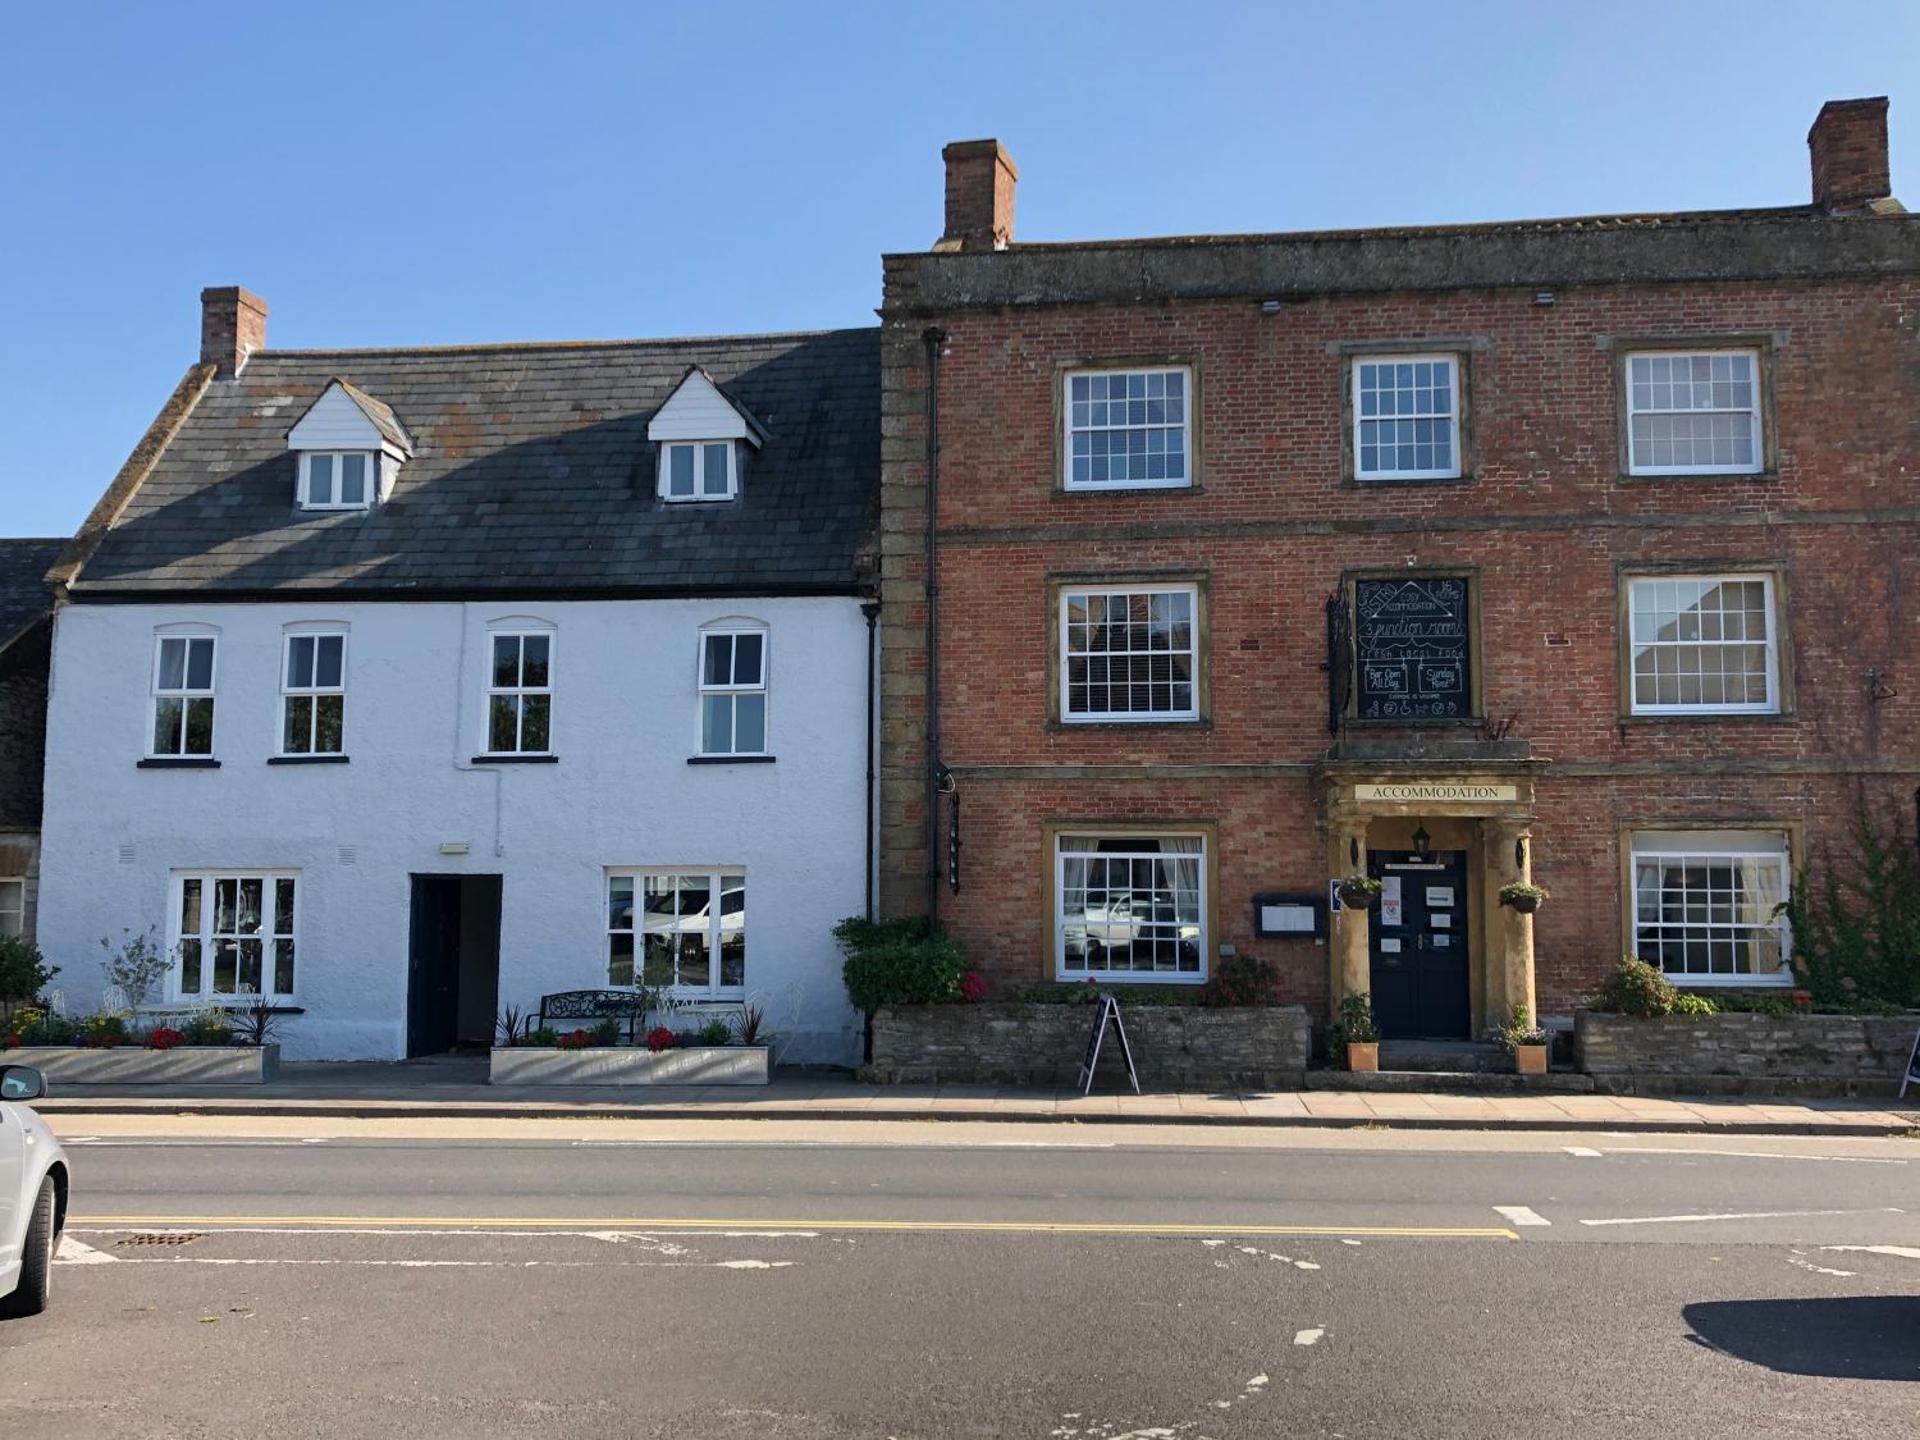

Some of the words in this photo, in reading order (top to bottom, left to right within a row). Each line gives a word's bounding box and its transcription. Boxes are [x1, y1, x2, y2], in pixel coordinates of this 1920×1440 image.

[1365, 623, 1373, 635] 3
[1370, 669, 1382, 679] Bar
[1426, 668, 1455, 682] Sunday
[1372, 679, 1383, 688] All
[1384, 679, 1400, 690] Day
[1373, 786, 1498, 798] ACCOMMODATION
